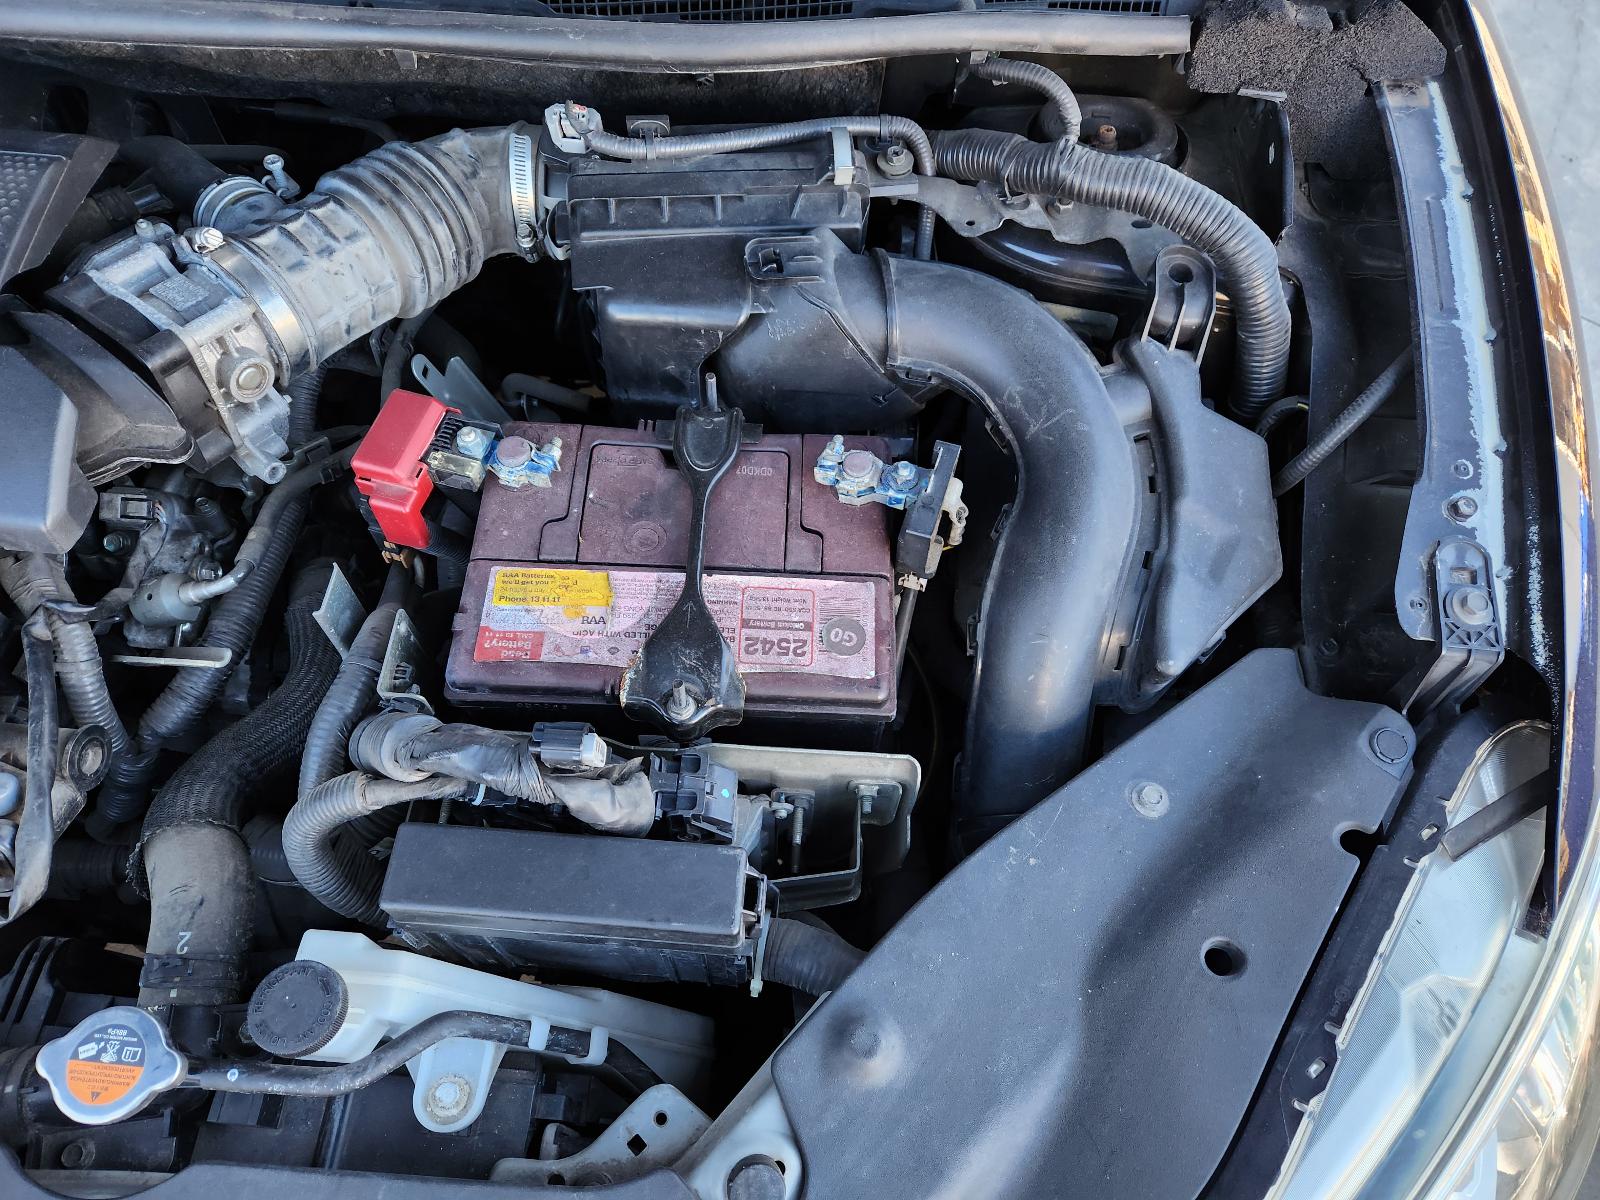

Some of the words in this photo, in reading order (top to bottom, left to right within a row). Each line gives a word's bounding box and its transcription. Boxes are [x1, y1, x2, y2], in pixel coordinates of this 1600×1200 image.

[581, 615, 606, 625] RAA
[623, 631, 650, 639] ILLED
[484, 638, 531, 649] Battery?
[744, 636, 808, 658] 2542
